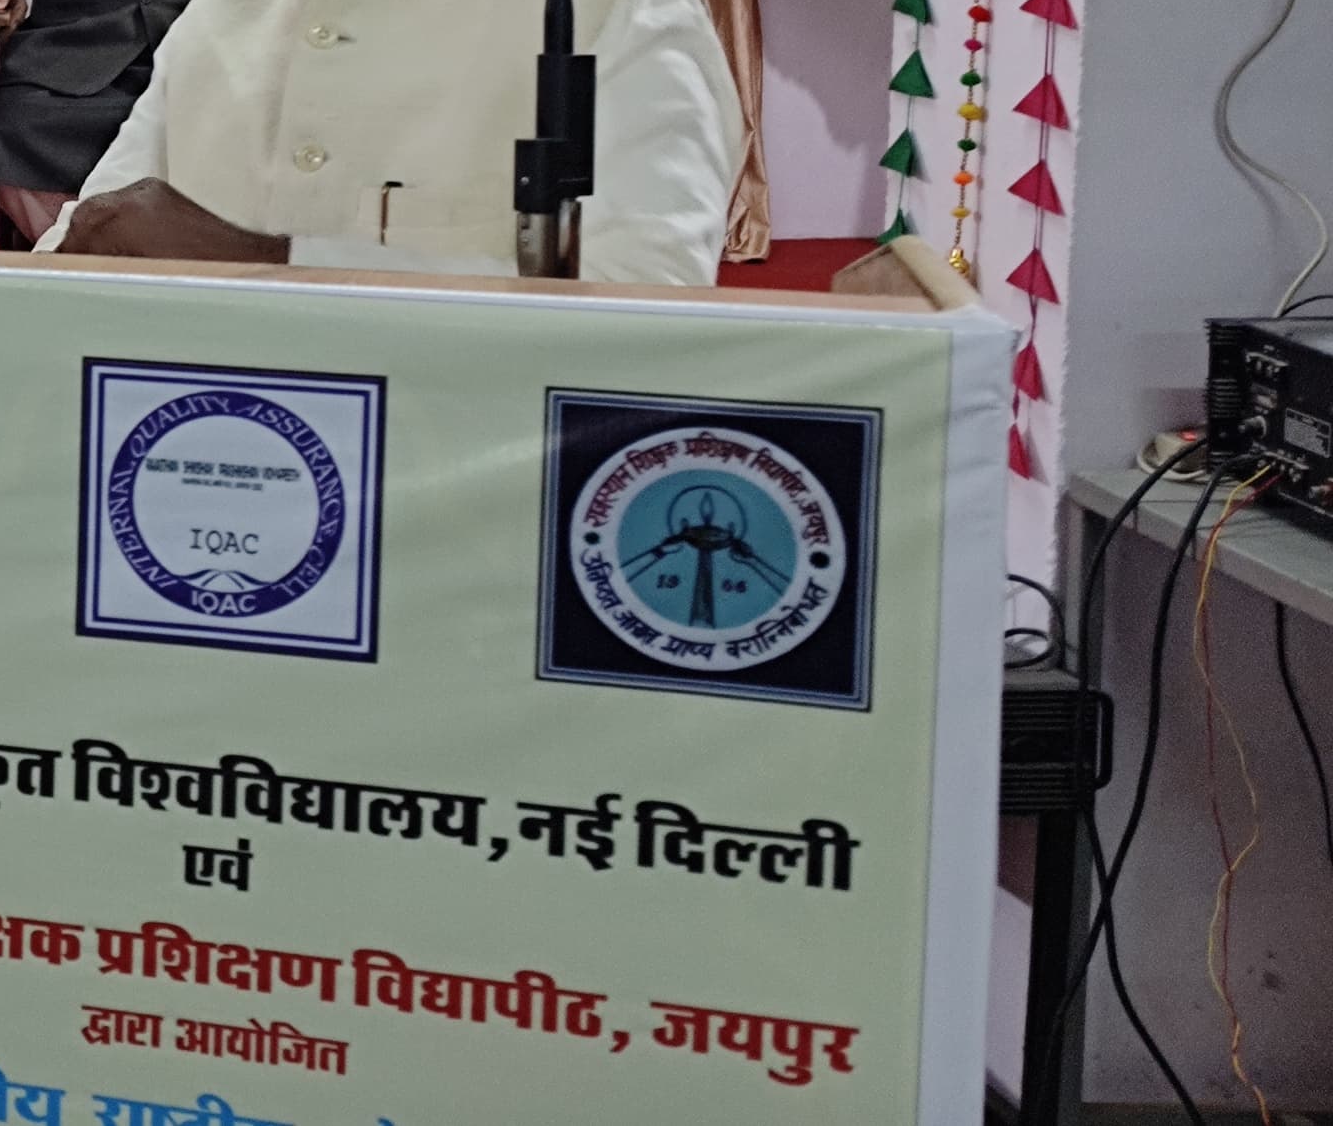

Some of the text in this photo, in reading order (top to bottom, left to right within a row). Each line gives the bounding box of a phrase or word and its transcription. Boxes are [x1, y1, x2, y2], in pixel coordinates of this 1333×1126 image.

[130, 395, 230, 458] QUALITY
[271, 545, 326, 597] CELL
[189, 528, 260, 555] IQAC
[191, 592, 256, 615] IQAC
[182, 837, 253, 892] एवं
[517, 793, 622, 871] नई
[635, 800, 860, 892] दिल्ली
[81, 1004, 349, 1076] द्वारा आयोजित
[96, 921, 342, 1004] प्रशिक्षण
[352, 948, 631, 1054] विद्यापीठ,
[650, 999, 860, 1088] जयपुर
